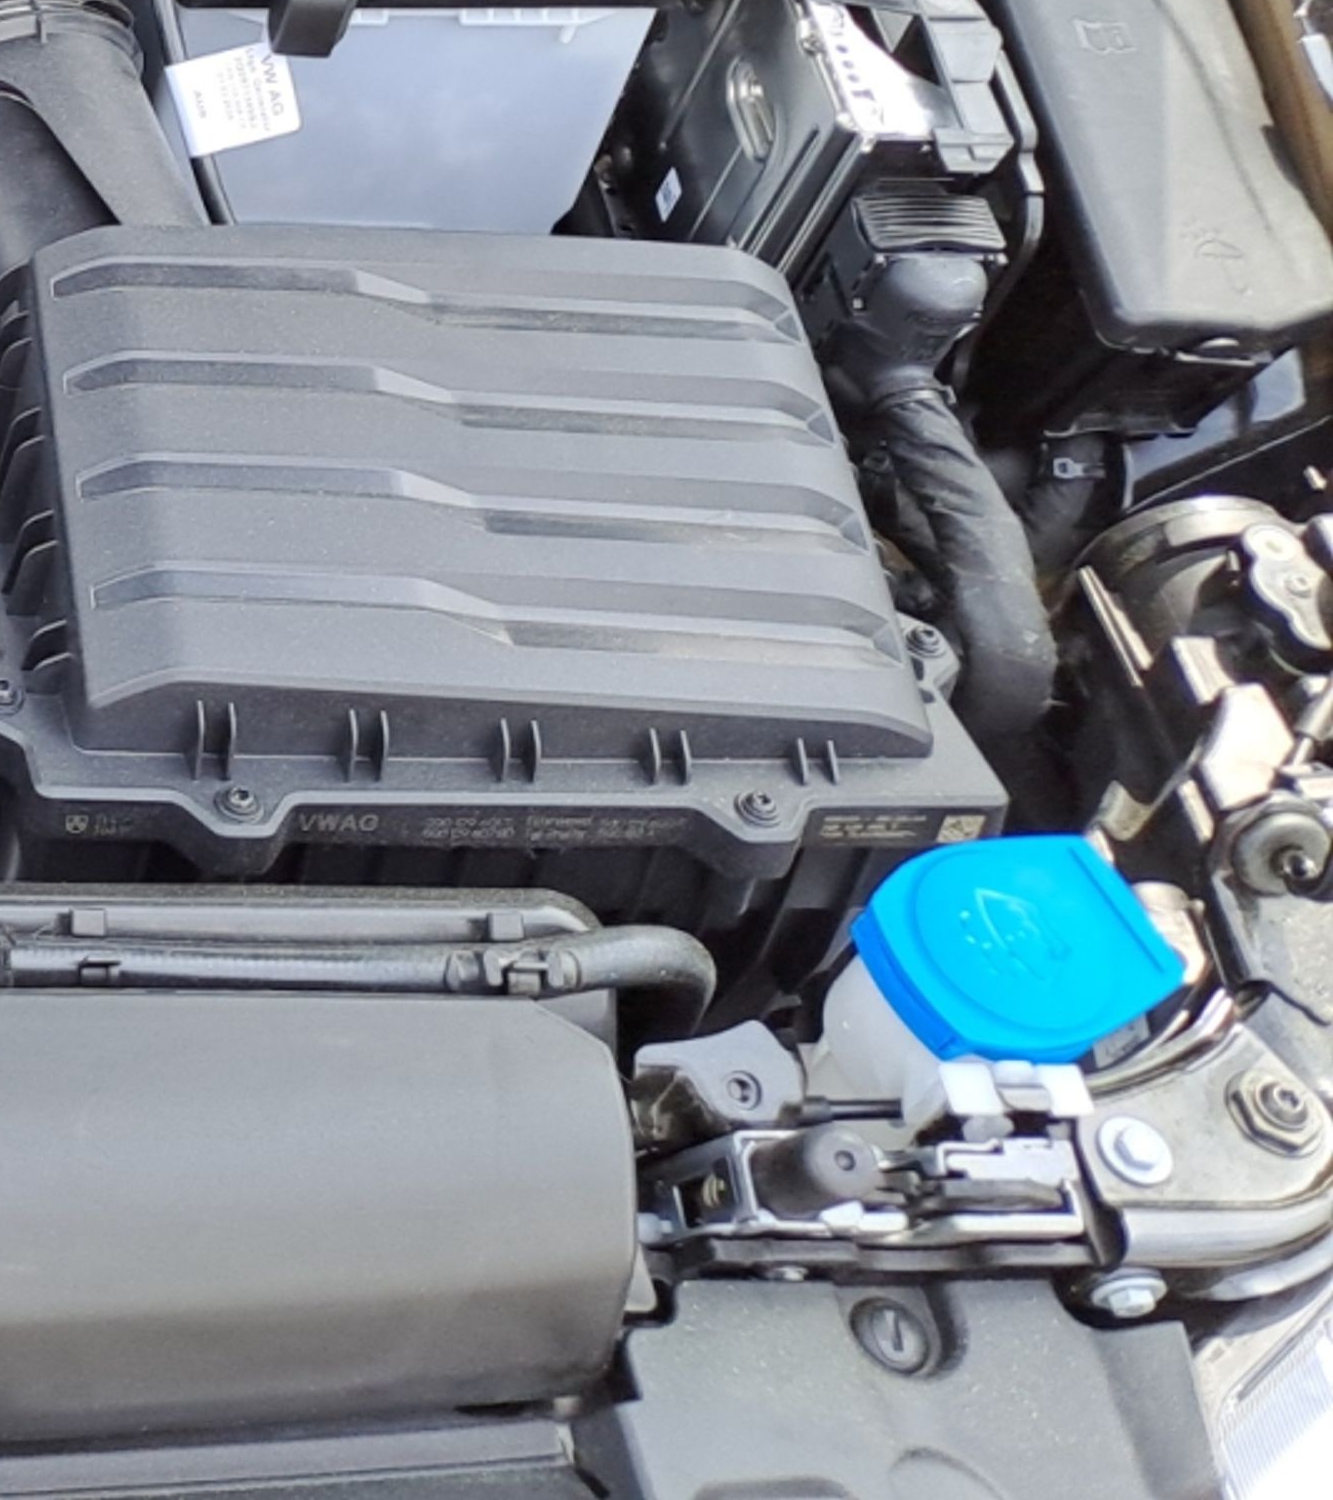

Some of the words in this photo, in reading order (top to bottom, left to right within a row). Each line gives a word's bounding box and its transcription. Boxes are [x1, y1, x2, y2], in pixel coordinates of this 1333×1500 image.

[260, 53, 279, 84] VW
[268, 90, 285, 117] AG
[297, 812, 379, 832] VWAG
